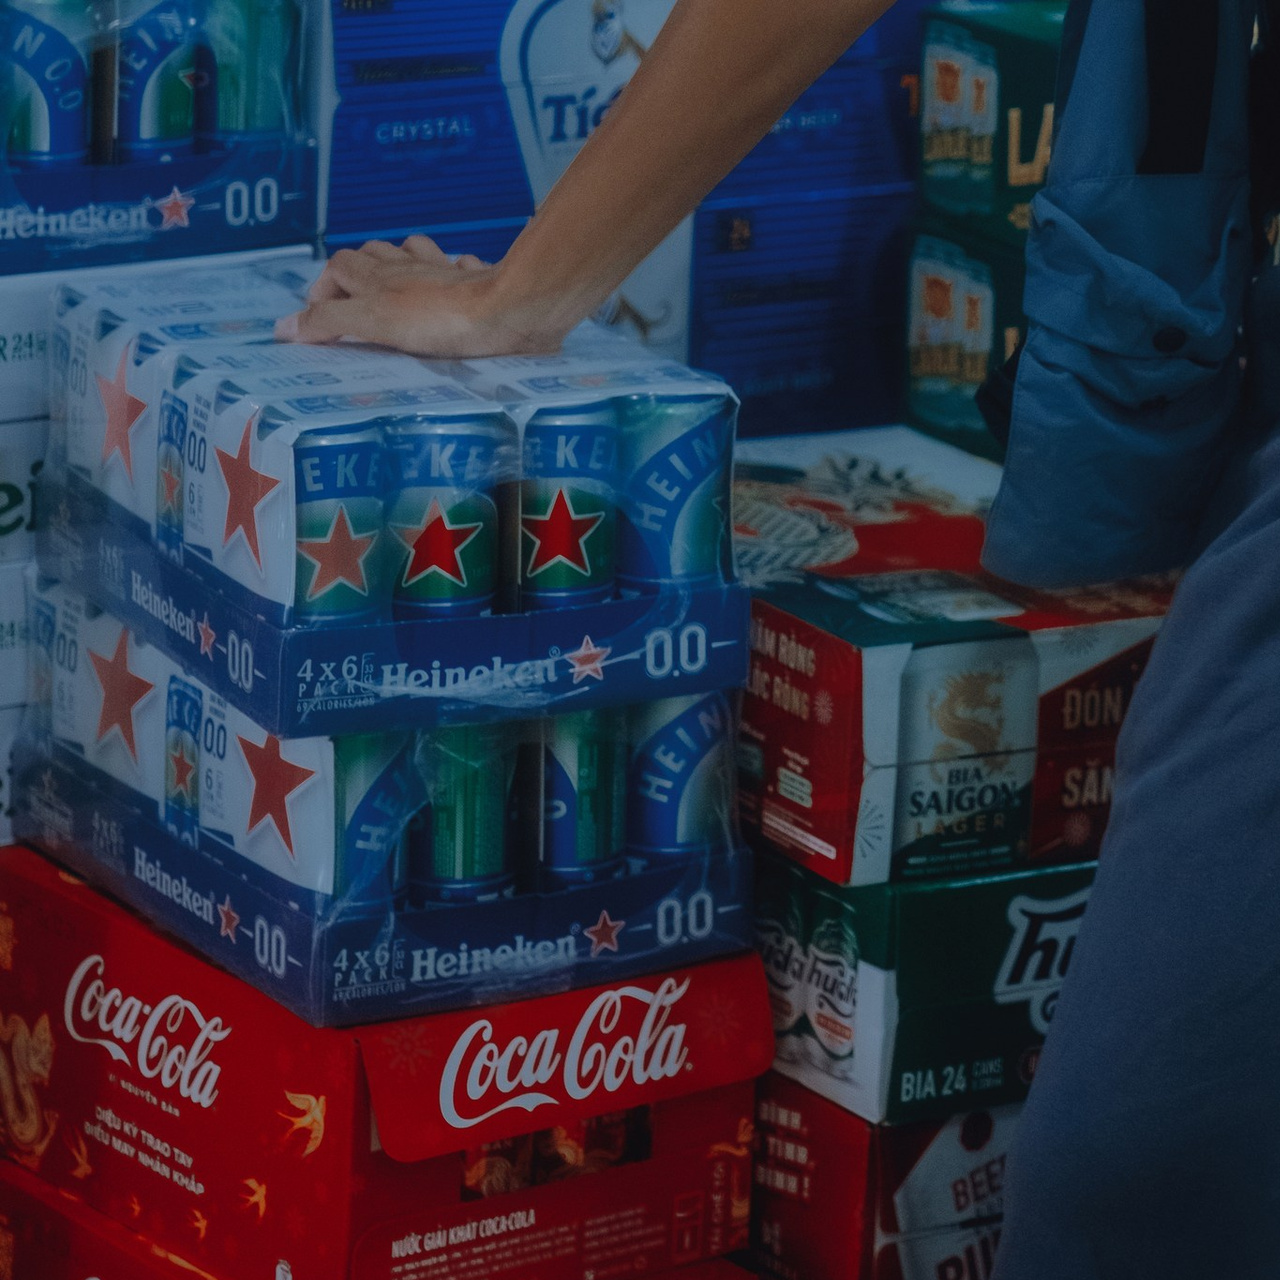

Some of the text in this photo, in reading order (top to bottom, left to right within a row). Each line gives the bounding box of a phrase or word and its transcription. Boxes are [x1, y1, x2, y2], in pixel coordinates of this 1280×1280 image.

[225, 177, 278, 227] 0.0
[187, 431, 207, 475] 0.0
[131, 570, 254, 694] Heineken 0.0
[644, 623, 708, 678] 0.0
[299, 680, 356, 698] PACK
[380, 653, 559, 698] Heineken
[203, 717, 227, 760] 0.0
[948, 766, 983, 787] BIA
[909, 781, 1019, 818] SAIGON
[916, 811, 1006, 839] LAGER
[133, 846, 287, 980] Heineken 0.0
[410, 935, 577, 982] Heineken
[656, 891, 715, 947] 0.0
[900, 1068, 937, 1103] BIA
[941, 1063, 968, 1097] 24
